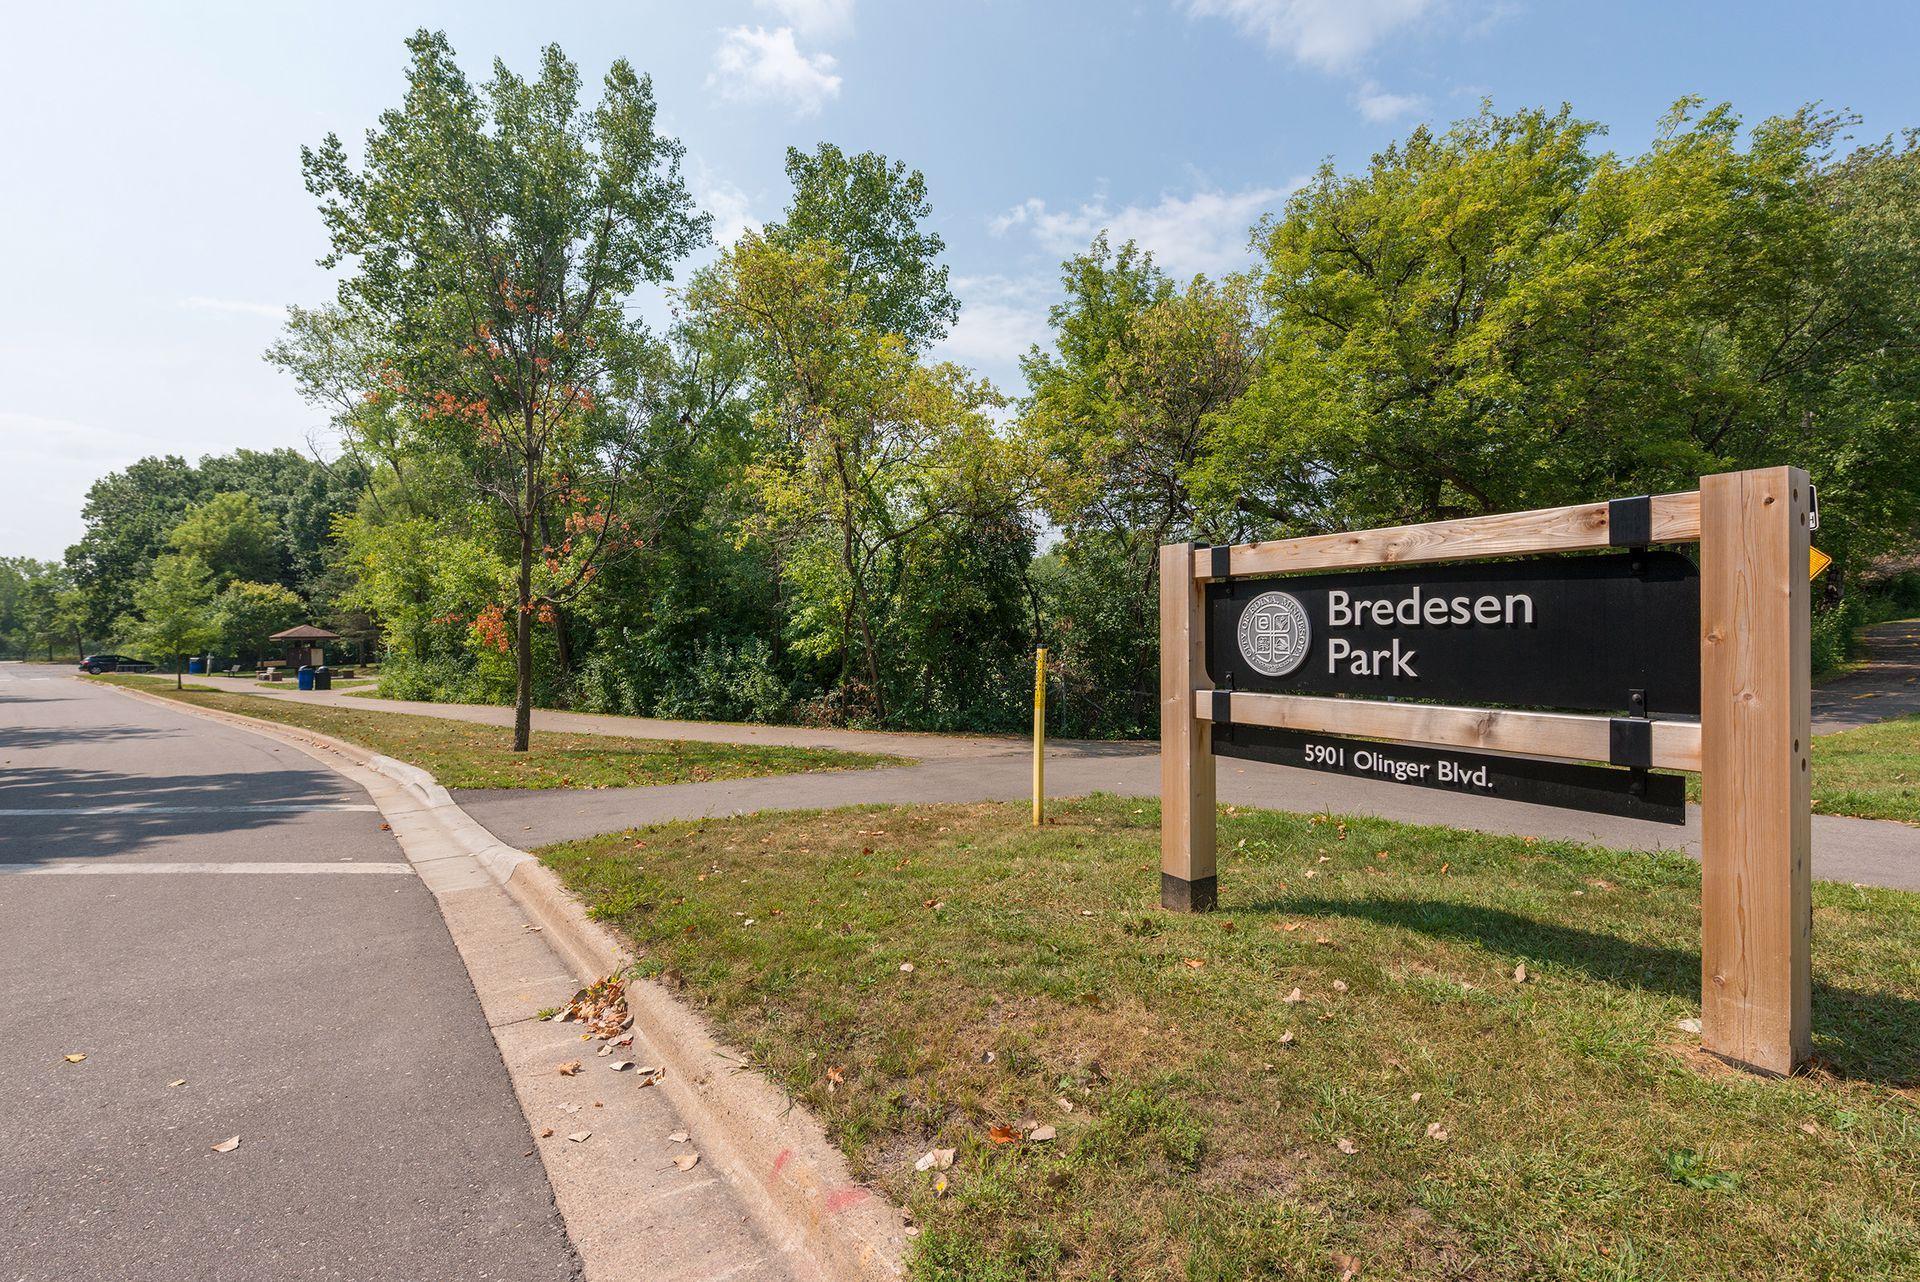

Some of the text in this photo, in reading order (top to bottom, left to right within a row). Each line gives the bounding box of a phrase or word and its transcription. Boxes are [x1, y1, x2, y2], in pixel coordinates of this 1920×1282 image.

[1241, 613, 1250, 629] OF
[1328, 586, 1534, 626] Bredesen
[1328, 638, 1419, 677] Park
[1304, 743, 1493, 788] 5901 Olinger Blvd.
